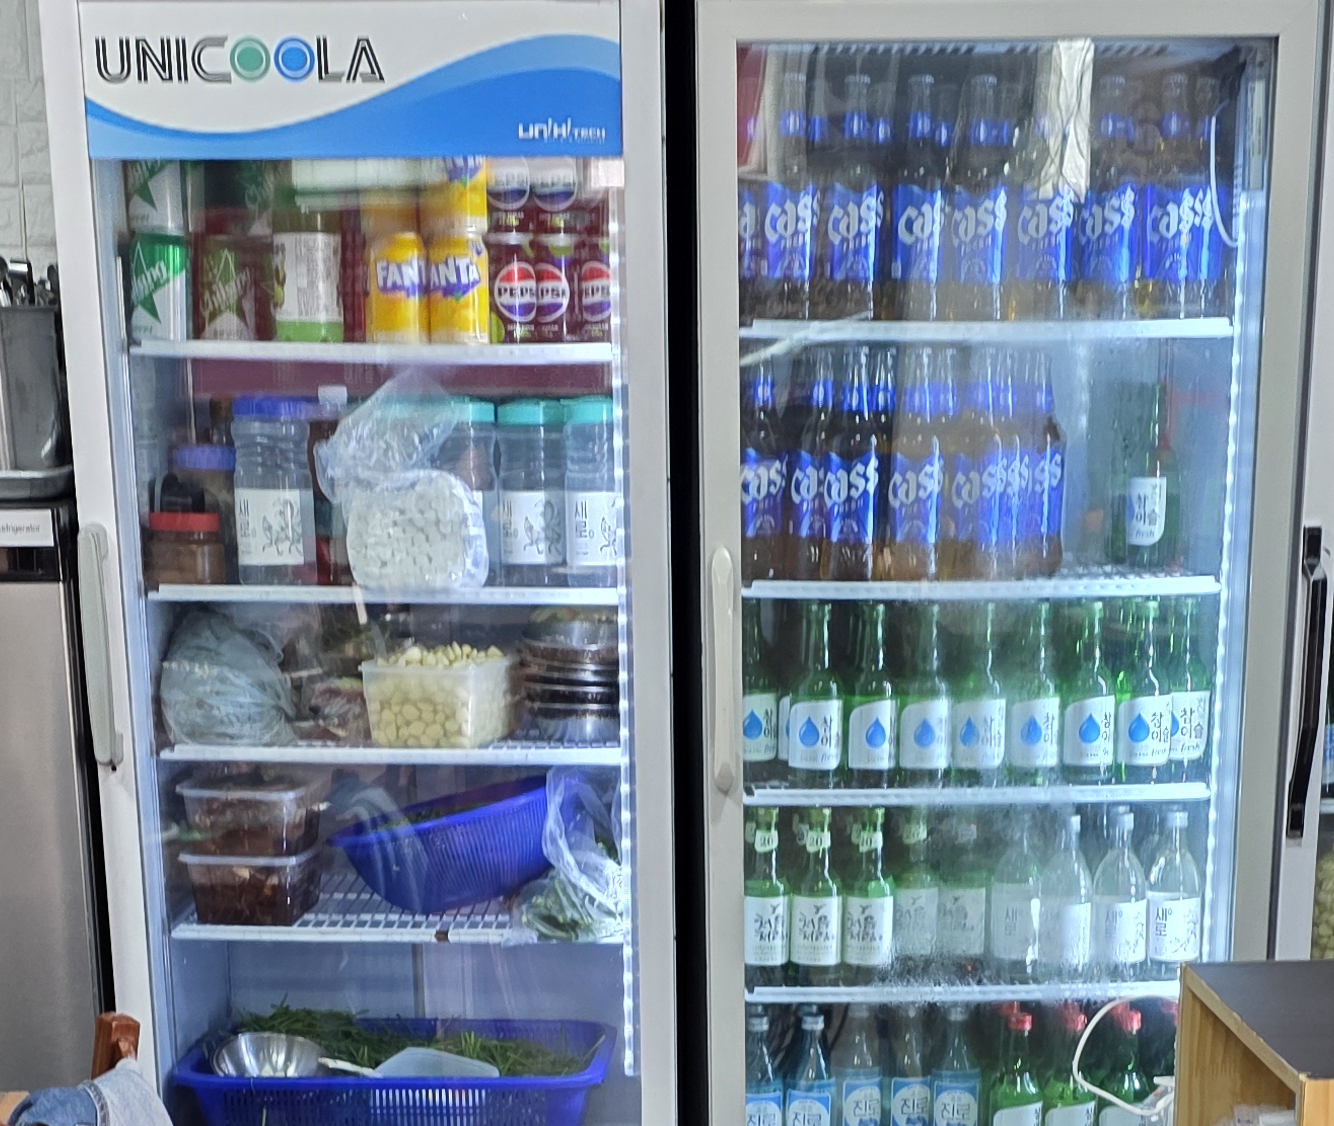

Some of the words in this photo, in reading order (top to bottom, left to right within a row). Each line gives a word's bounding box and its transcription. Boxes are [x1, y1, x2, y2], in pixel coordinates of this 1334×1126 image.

[94, 35, 386, 85] UNICOOLA
[375, 257, 426, 290] FANT
[429, 255, 481, 290] ANTA
